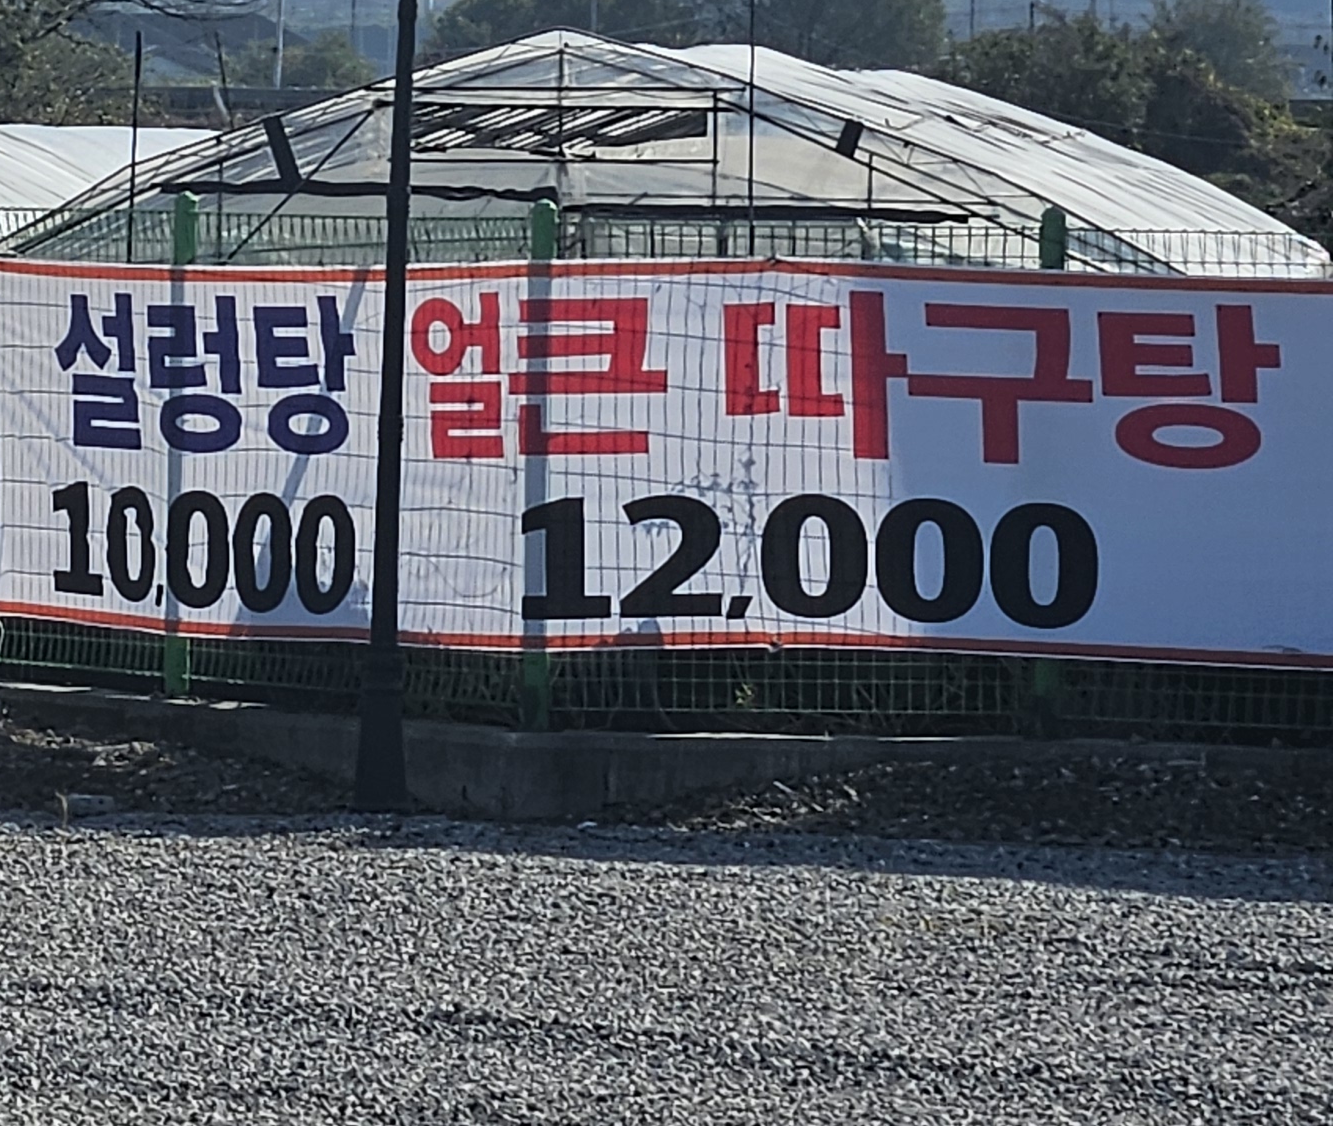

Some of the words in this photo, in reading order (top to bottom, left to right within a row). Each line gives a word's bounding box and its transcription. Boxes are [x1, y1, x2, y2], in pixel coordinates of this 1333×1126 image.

[54, 292, 356, 455] 설렁탕
[410, 291, 668, 459] 얼큰
[722, 290, 1281, 469] 따구탕
[52, 480, 356, 616] 10,000
[520, 492, 1099, 629] 12,000
